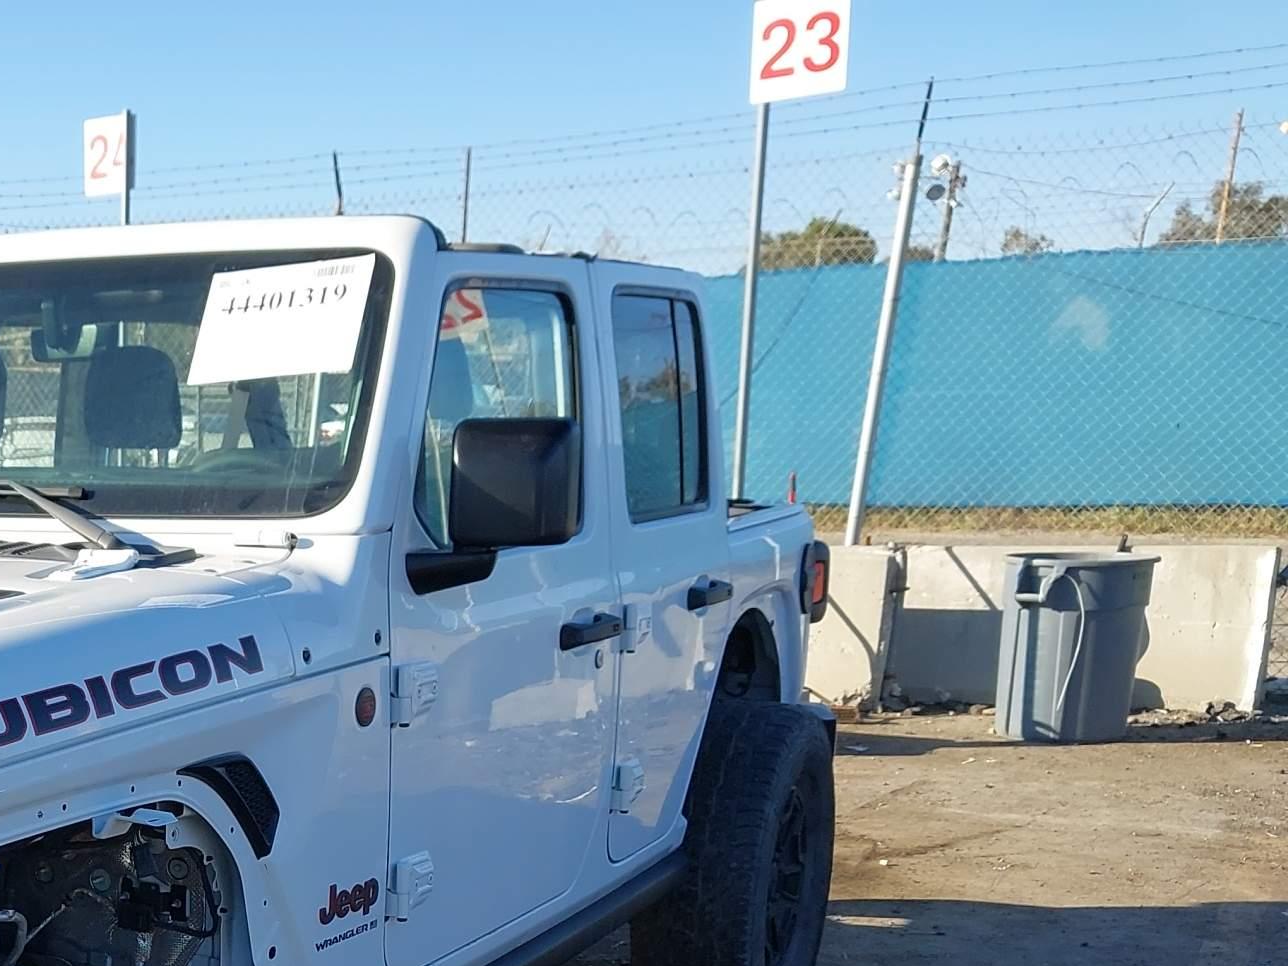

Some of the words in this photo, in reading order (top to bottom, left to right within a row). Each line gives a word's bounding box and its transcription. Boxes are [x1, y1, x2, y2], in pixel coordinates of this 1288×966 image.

[760, 11, 840, 79] 23
[222, 284, 347, 314] 44401319
[319, 878, 379, 925] Jeep
[315, 923, 369, 952] WRANGLER
